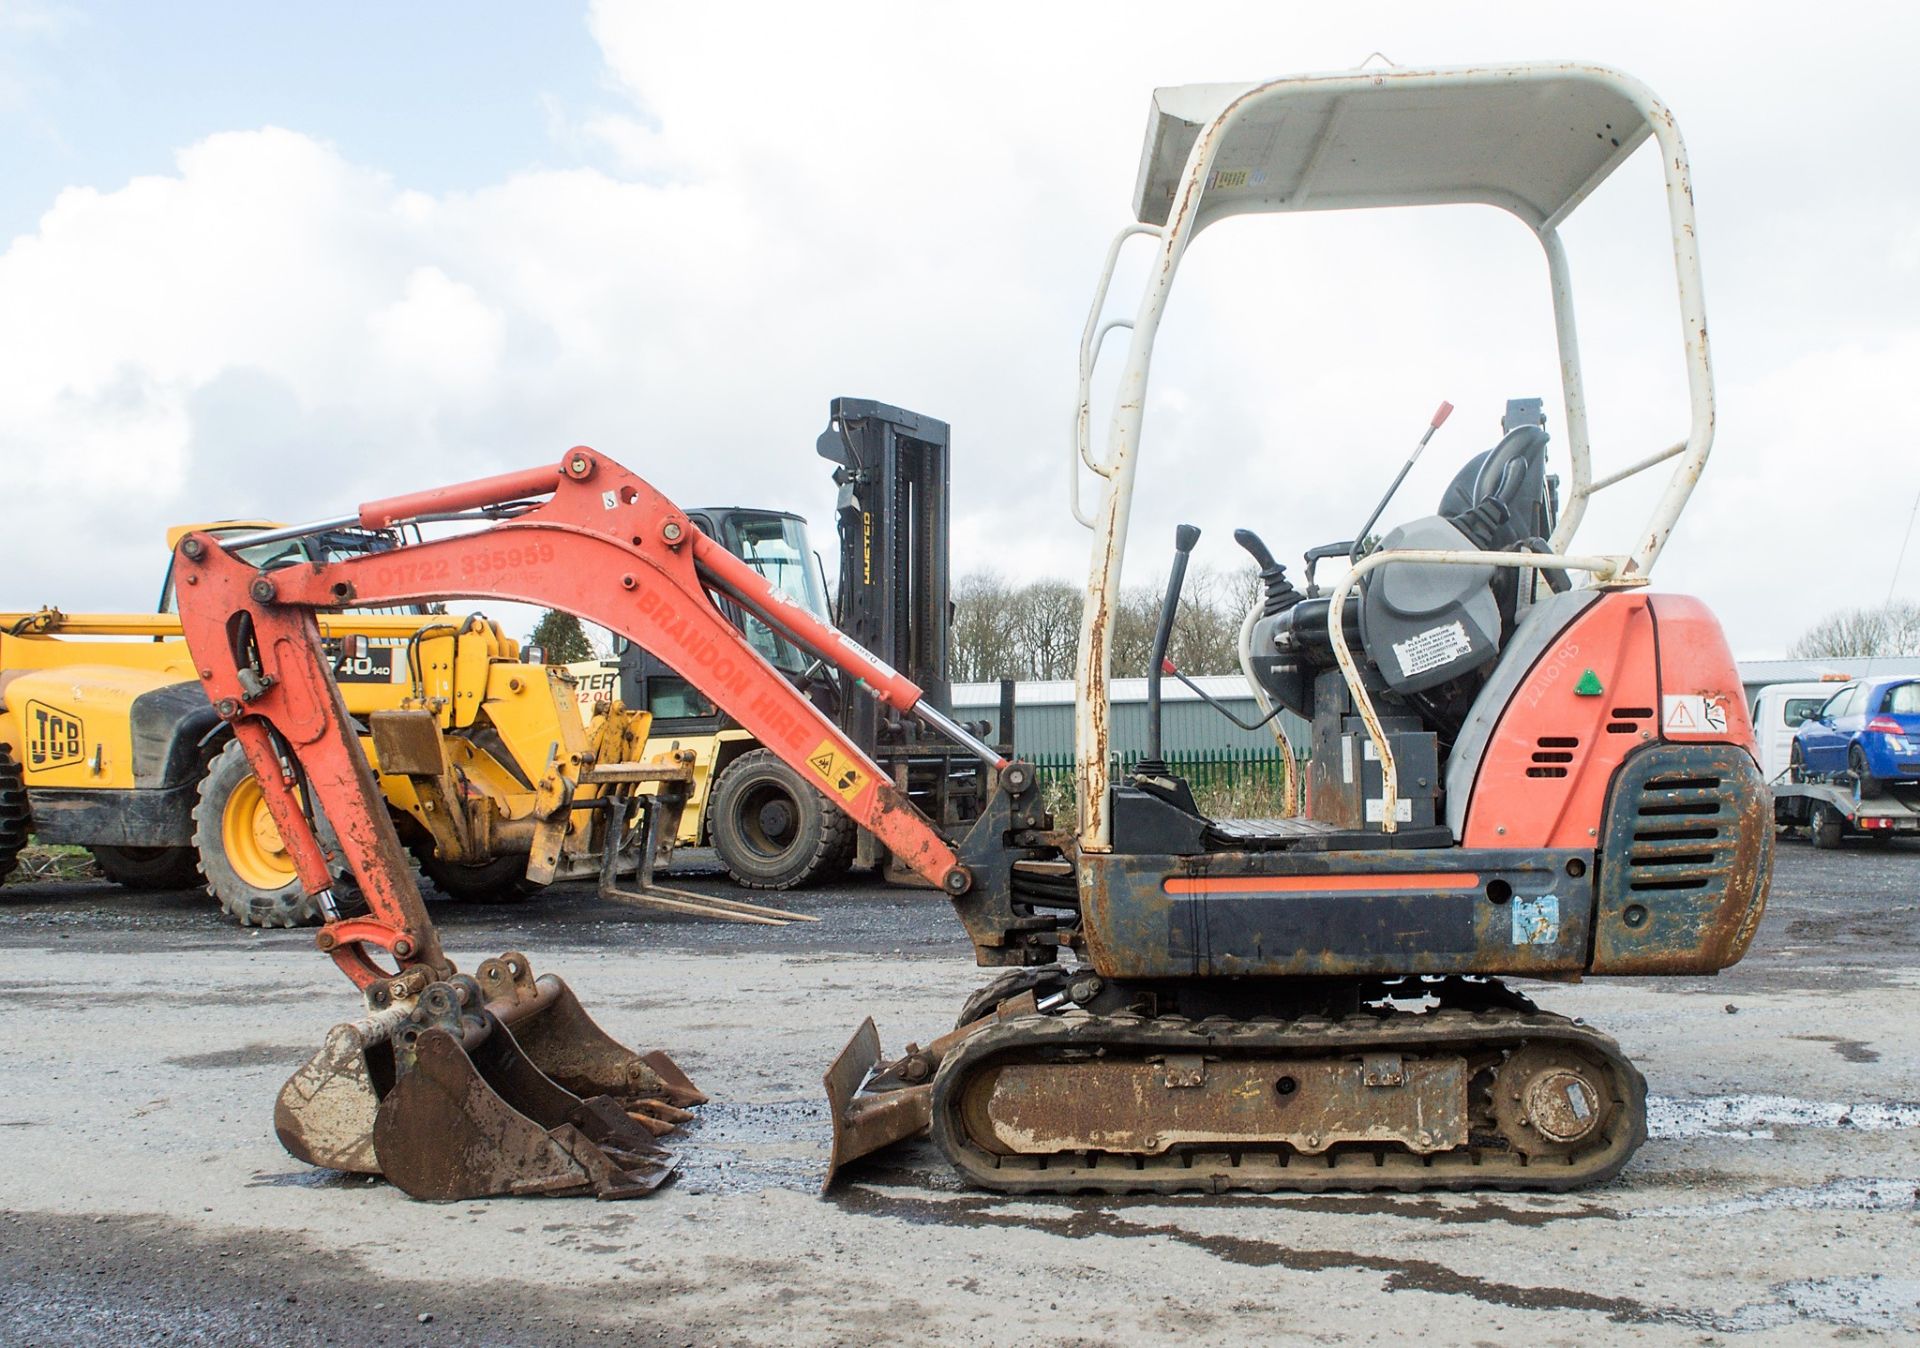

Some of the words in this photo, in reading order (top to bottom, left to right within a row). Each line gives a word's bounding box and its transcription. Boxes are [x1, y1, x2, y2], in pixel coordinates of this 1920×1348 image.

[377, 559, 449, 586] 01722
[635, 590, 752, 696] BRANDON
[751, 691, 811, 750] HIRE
[32, 708, 79, 764] JCB
